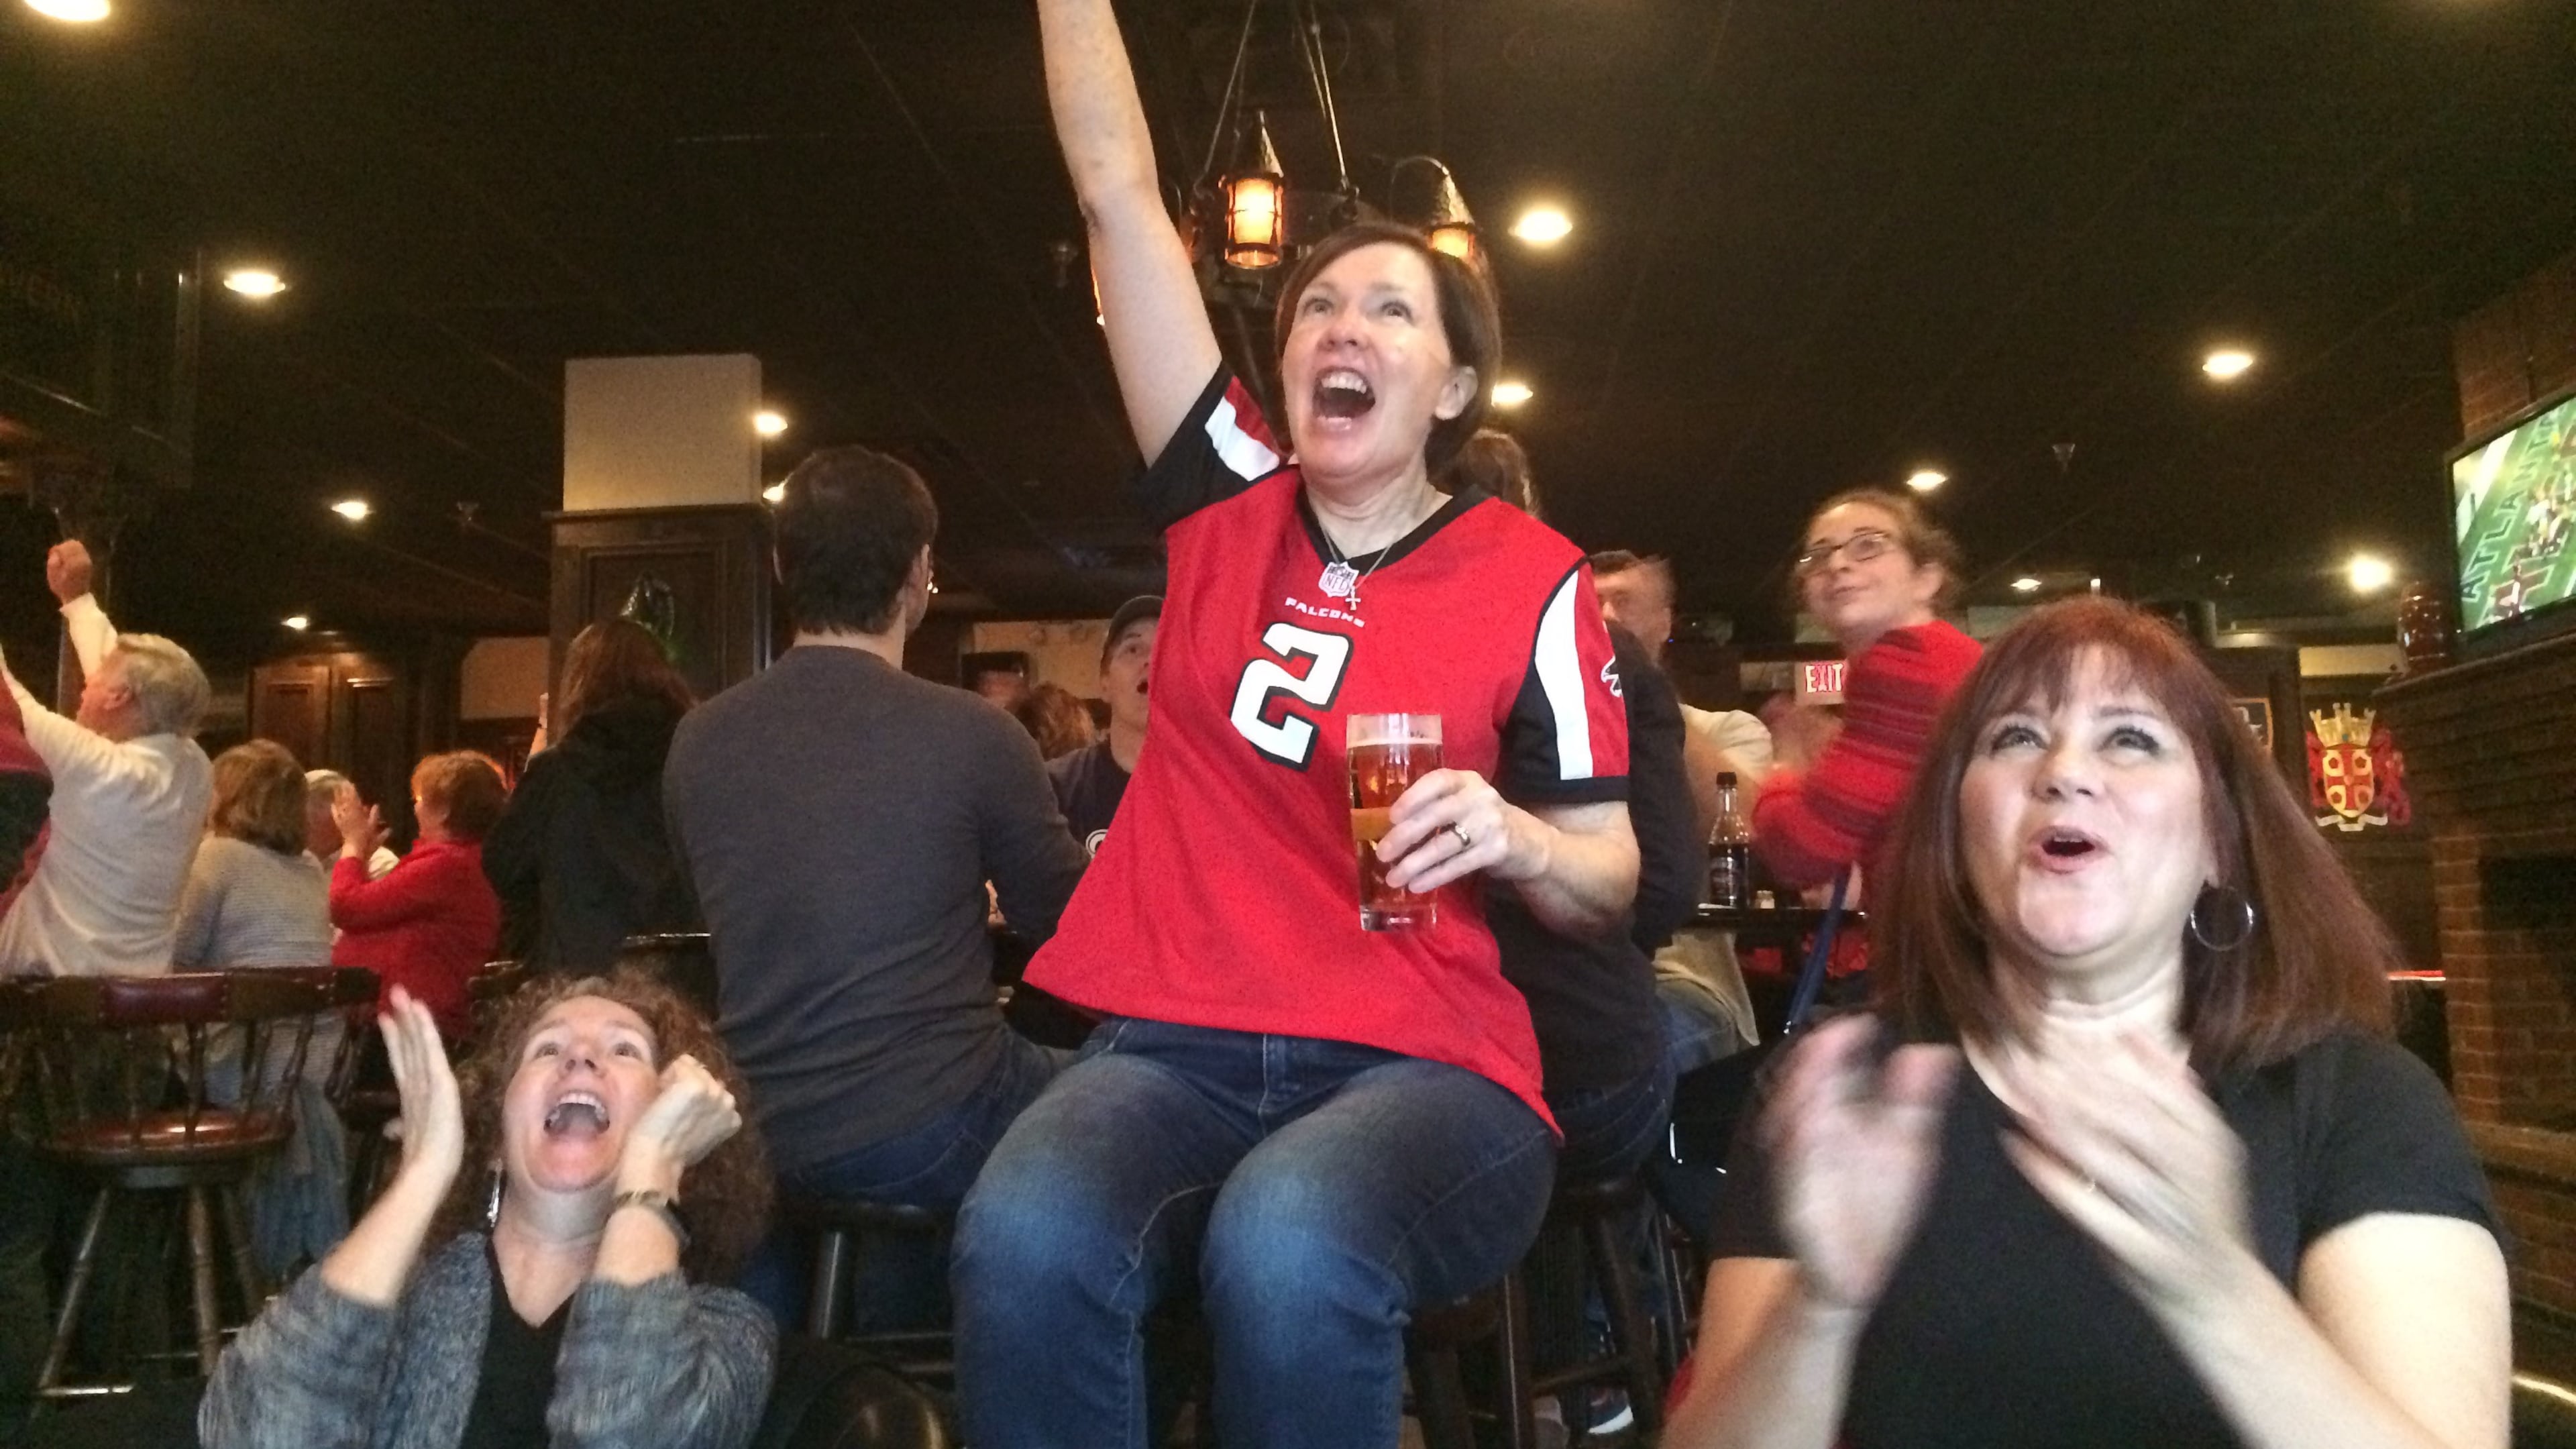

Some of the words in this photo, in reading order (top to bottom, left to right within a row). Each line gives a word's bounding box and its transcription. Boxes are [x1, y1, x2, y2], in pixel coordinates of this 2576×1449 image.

[1325, 574, 1350, 591] NFL
[1285, 596, 1365, 628] FALCONS
[1805, 663, 1843, 693] EXIT
[1230, 621, 1353, 771] 2
